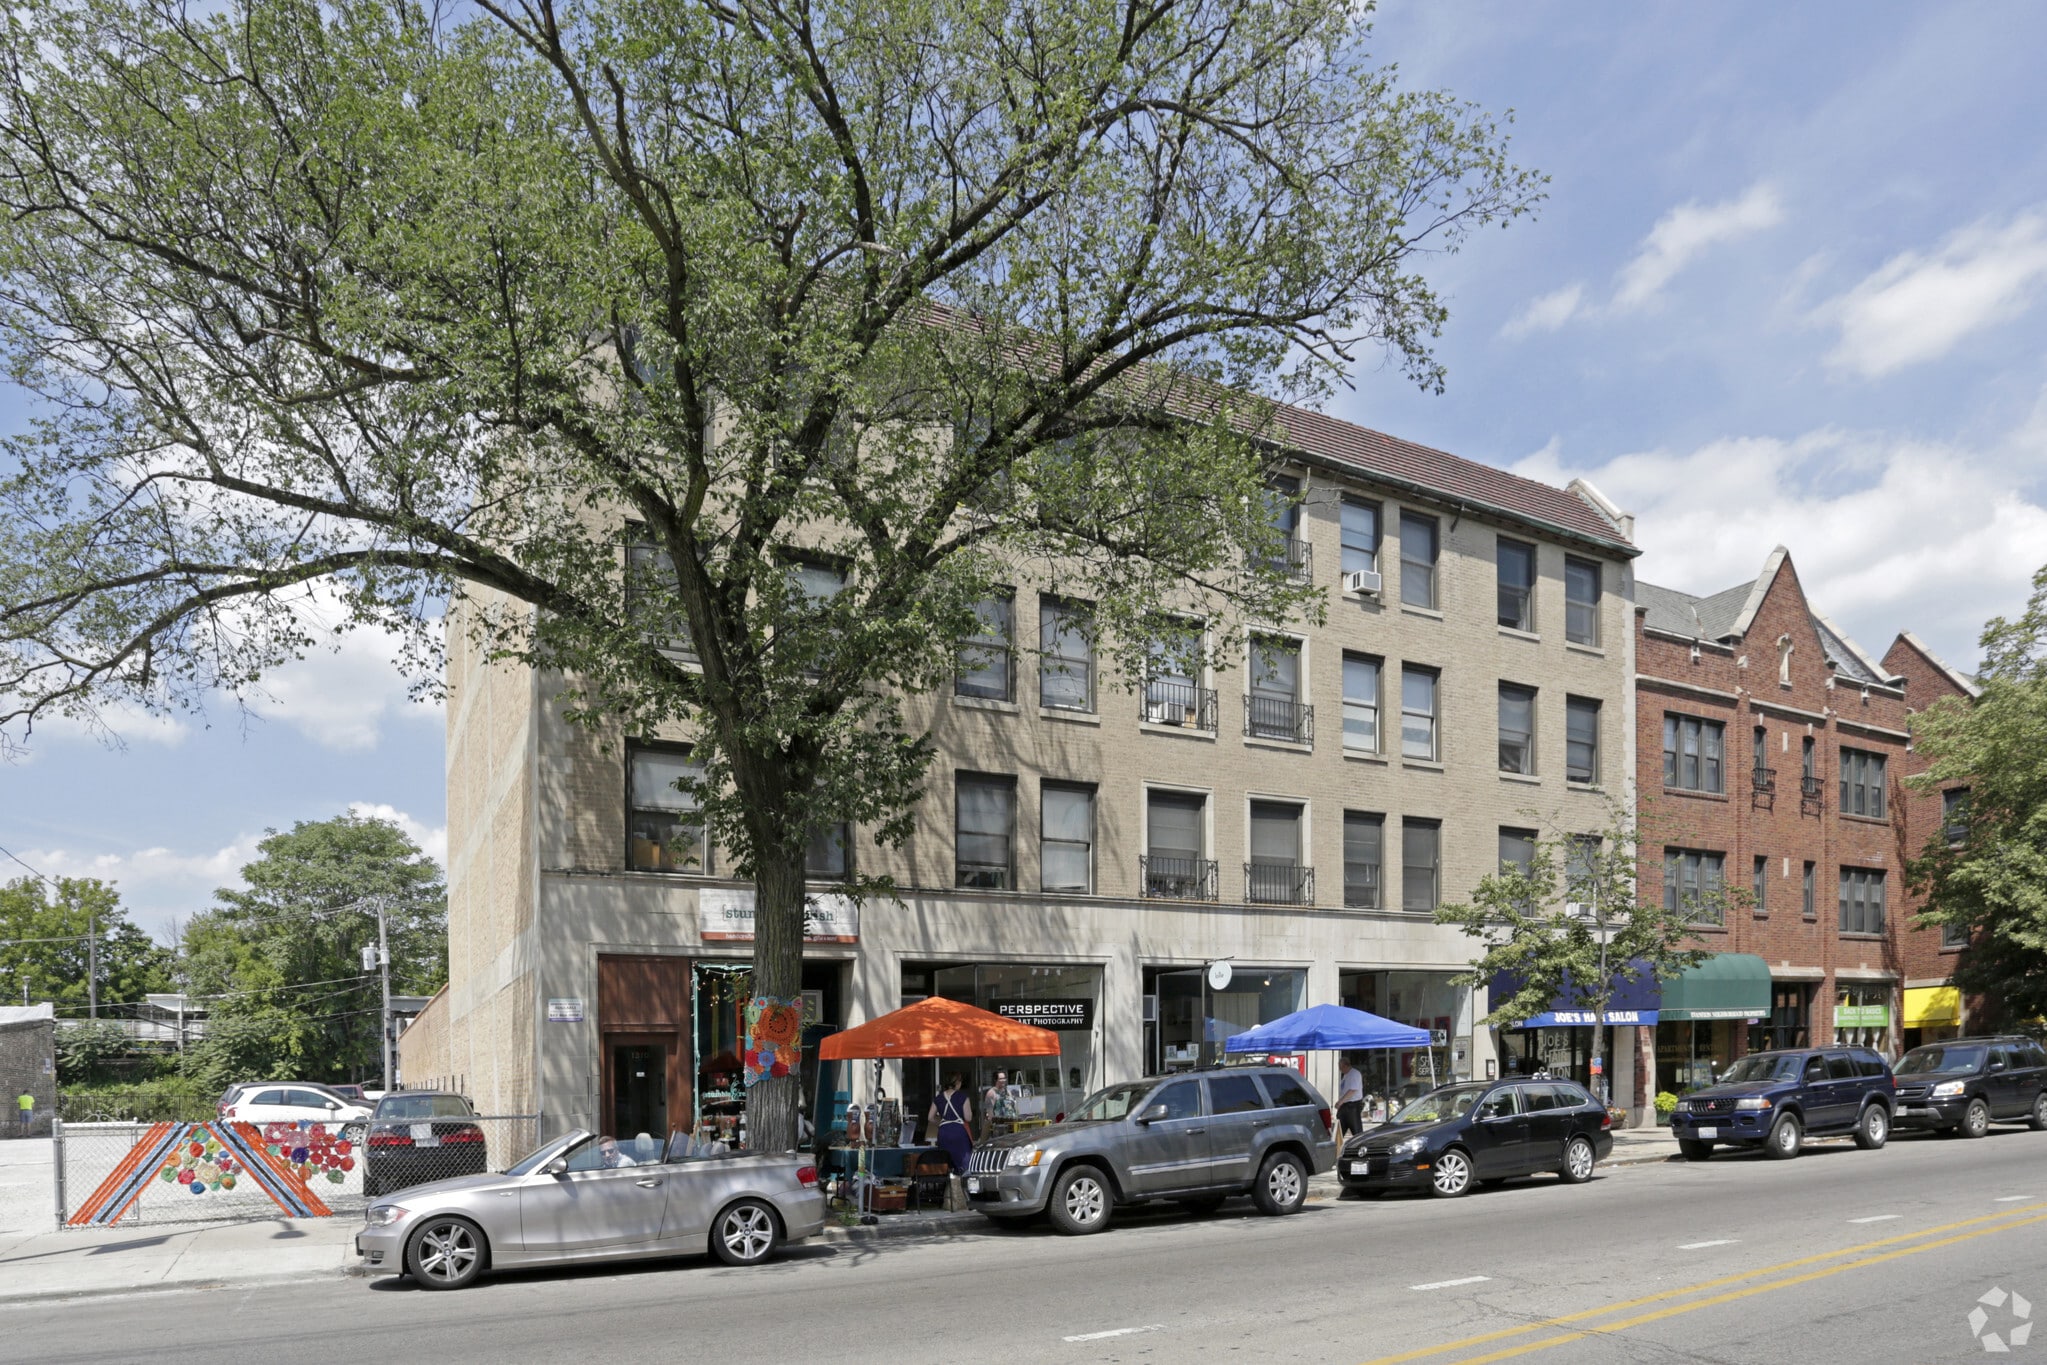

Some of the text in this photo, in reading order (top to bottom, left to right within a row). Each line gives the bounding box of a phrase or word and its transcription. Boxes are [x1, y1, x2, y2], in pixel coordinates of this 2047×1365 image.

[1000, 1004, 1084, 1014] PERSPECTIVE
[1555, 1011, 1639, 1022] JOE'S HA SALON
[1544, 1049, 1568, 1063] HAIR
